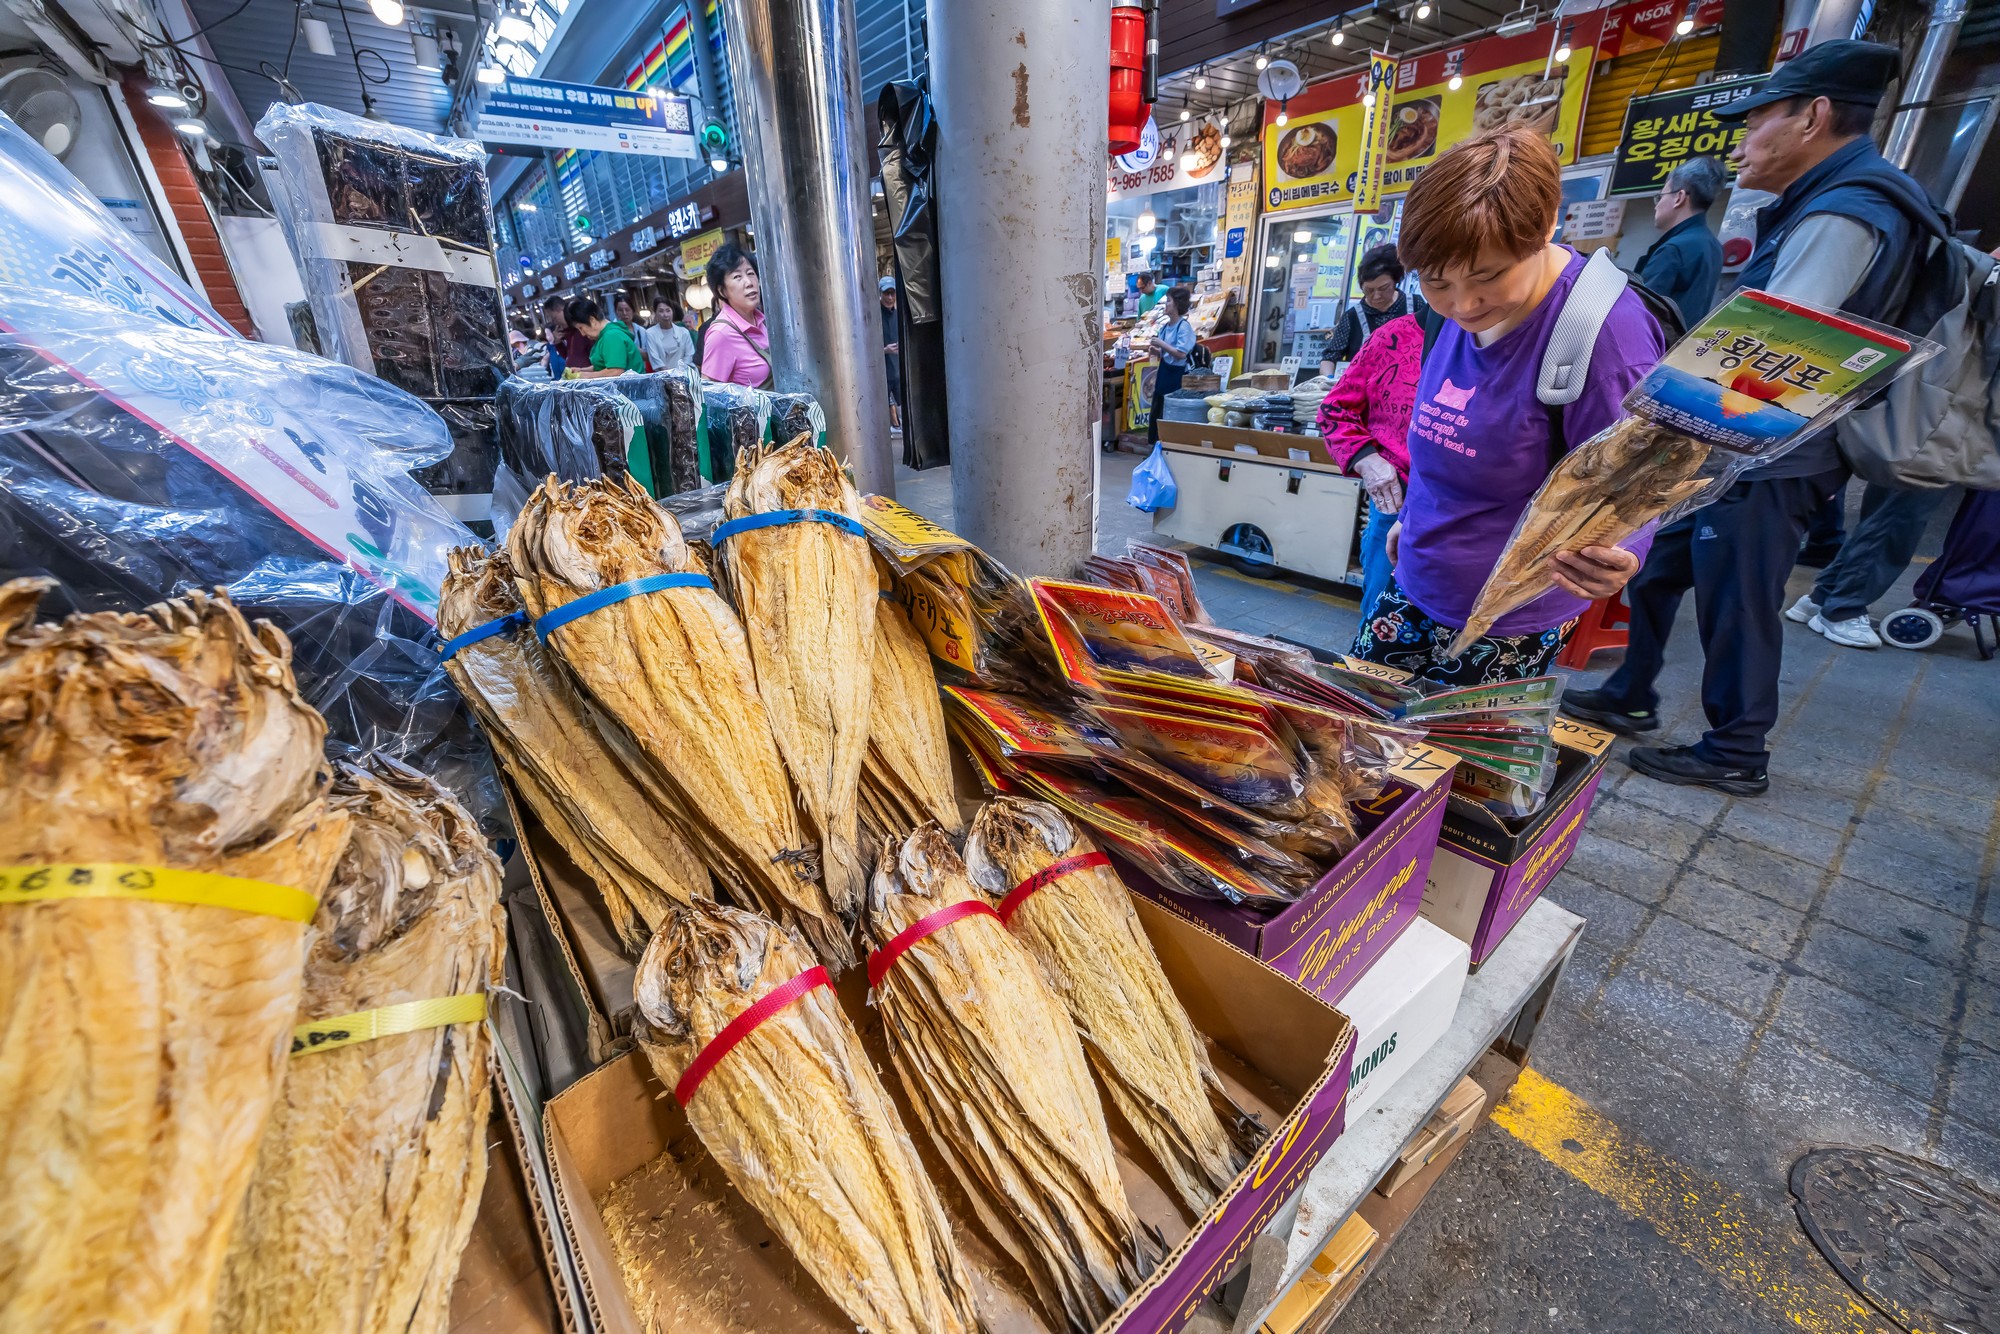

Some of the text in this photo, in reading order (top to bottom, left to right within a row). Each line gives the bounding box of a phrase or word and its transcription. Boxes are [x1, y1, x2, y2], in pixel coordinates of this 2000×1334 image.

[590, 93, 613, 107] 가게
[1283, 181, 1340, 201] 비빔메밀국수
[1718, 335, 1835, 392] 황태포
[1443, 437, 1465, 454] teach
[1442, 824, 1465, 838] ODUIT
[1290, 858, 1365, 934] CALIFORNIA'S
[1367, 824, 1401, 861] FINEST
[1403, 784, 1443, 827] WALNUTS
[1158, 893, 1191, 918] PRODUIT
[1311, 902, 1400, 996] nden's Best
[1347, 1031, 1398, 1094] MONDS
[1183, 1149, 1320, 1322] CALIFORNIA'S
